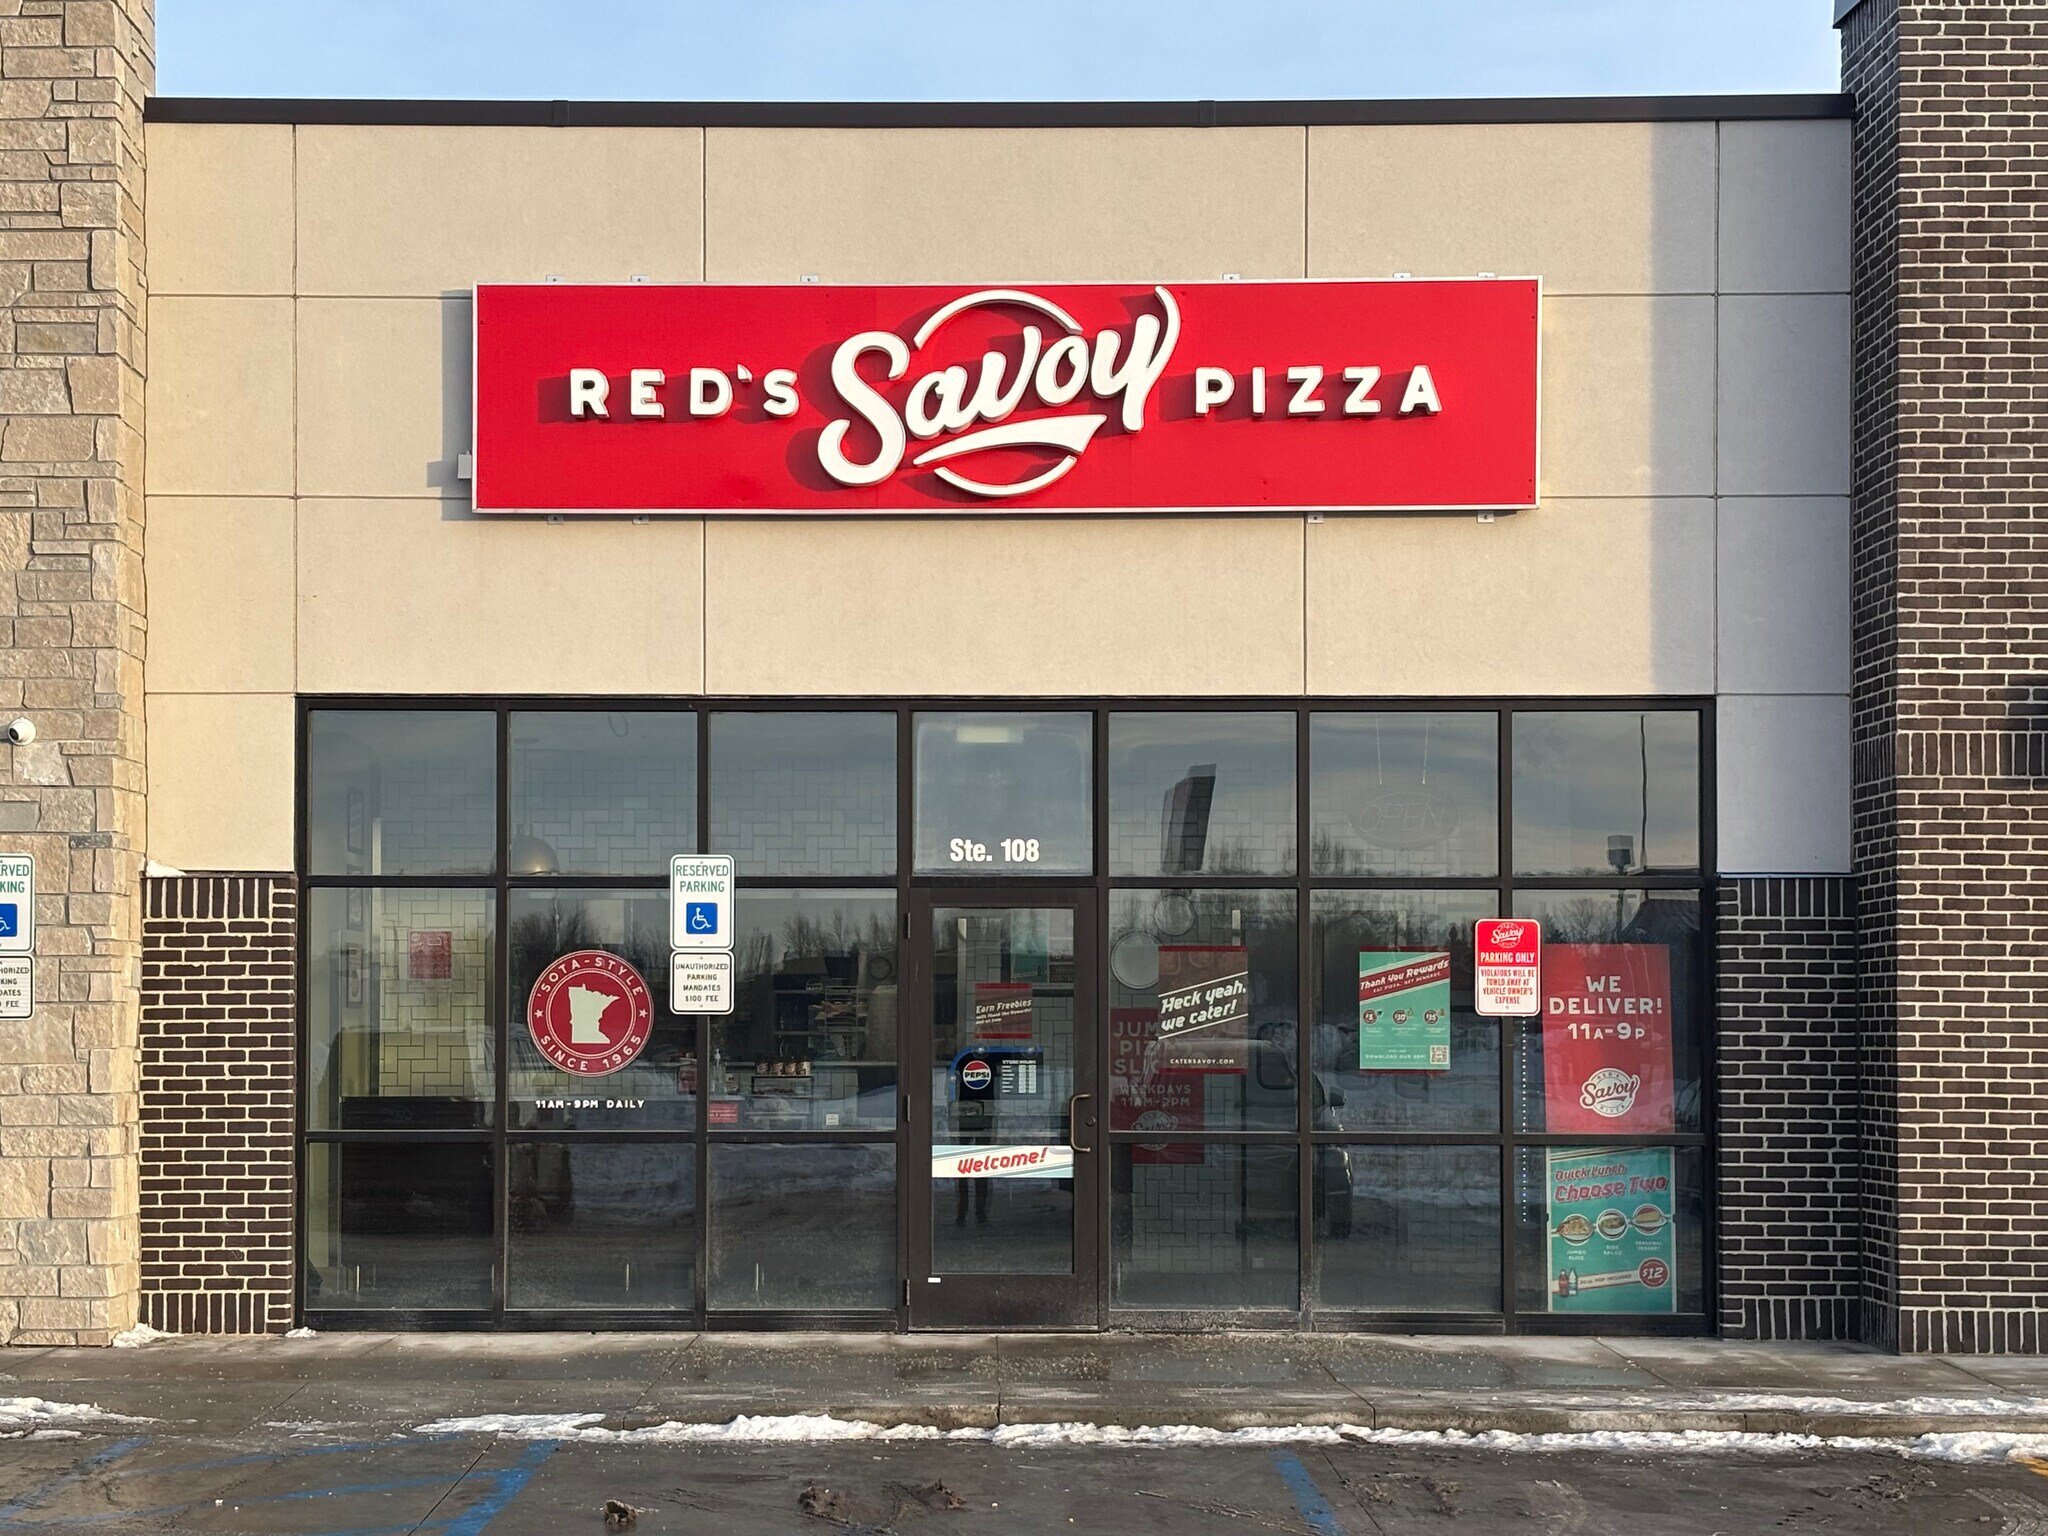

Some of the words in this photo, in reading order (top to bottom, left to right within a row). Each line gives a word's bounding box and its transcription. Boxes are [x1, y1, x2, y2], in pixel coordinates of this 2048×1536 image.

[569, 364, 799, 418] RED'S
[817, 285, 1181, 487] Savoy
[1195, 364, 1442, 417] PIZZA
[950, 838, 993, 862] Ste.
[1000, 838, 1040, 862] 108
[0, 864, 30, 877] RVED
[675, 864, 729, 877] RESERVED
[680, 881, 725, 893] PARKING
[1491, 925, 1524, 944] Savoy
[1480, 952, 1514, 963] PARKING
[1515, 952, 1535, 963] ONLY
[1360, 976, 1387, 991] Thank
[1388, 972, 1405, 983] You
[1406, 959, 1449, 978] Rewards
[1481, 969, 1511, 977] VIOLATORS
[1513, 969, 1526, 977] WILL
[1527, 969, 1535, 977] BE
[1483, 987, 1506, 995] VEHICLE
[1507, 987, 1533, 995] OWNER'S
[1585, 975, 1622, 992] WE
[975, 1004, 995, 1014] Earn
[997, 999, 1032, 1012] Freebies
[1160, 990, 1202, 1014] Heck
[1495, 996, 1520, 1004] EXPENSE
[1550, 997, 1662, 1015] DELIVER!
[1161, 1015, 1186, 1031] we
[1189, 999, 1238, 1025] cater!
[1113, 1021, 1158, 1037] JUM
[1567, 1022, 1646, 1040] 11A-9P
[541, 1035, 588, 1071] SINCE
[602, 1035, 641, 1069] 1965
[1120, 1084, 1192, 1095] WEEKDAYS
[1582, 1075, 1639, 1106] Savoy
[606, 1099, 645, 1109] DAILY
[957, 1146, 1049, 1175] Welcome!
[1555, 1167, 1591, 1182] Quick
[1591, 1163, 1627, 1178] Lunch
[1555, 1181, 1627, 1203] Choose
[1629, 1174, 1669, 1195] Two
[1642, 1266, 1665, 1279] $12
